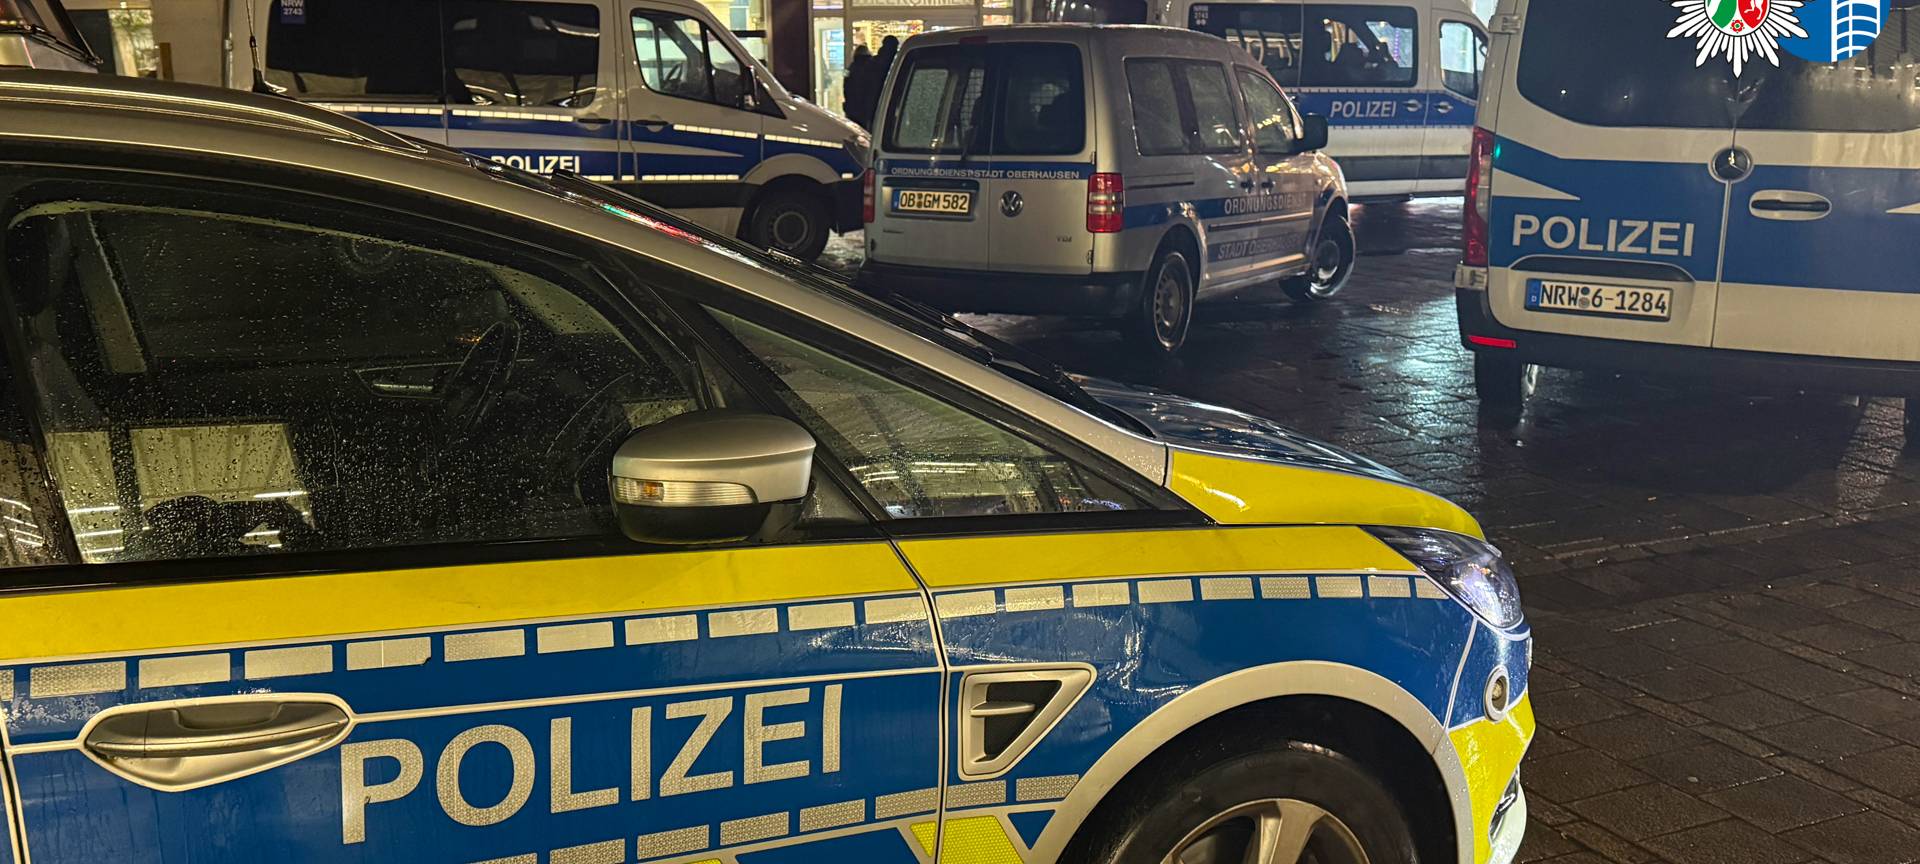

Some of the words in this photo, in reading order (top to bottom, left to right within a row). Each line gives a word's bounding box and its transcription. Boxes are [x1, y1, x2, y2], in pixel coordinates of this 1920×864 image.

[1330, 101, 1397, 118] POLIZEI
[891, 167, 973, 177] ORDNUNGSDIENST
[974, 170, 1003, 178] STADT
[1007, 171, 1080, 179] OBERHAUSEN
[900, 192, 916, 207] OB
[924, 193, 941, 208] GM
[942, 194, 968, 210] 582
[1512, 214, 1695, 256] POLIZEI
[1218, 241, 1249, 259] STADT
[1541, 284, 1580, 307] NRW
[1591, 287, 1667, 314] 6-1284
[340, 684, 843, 845] POLIZEI
